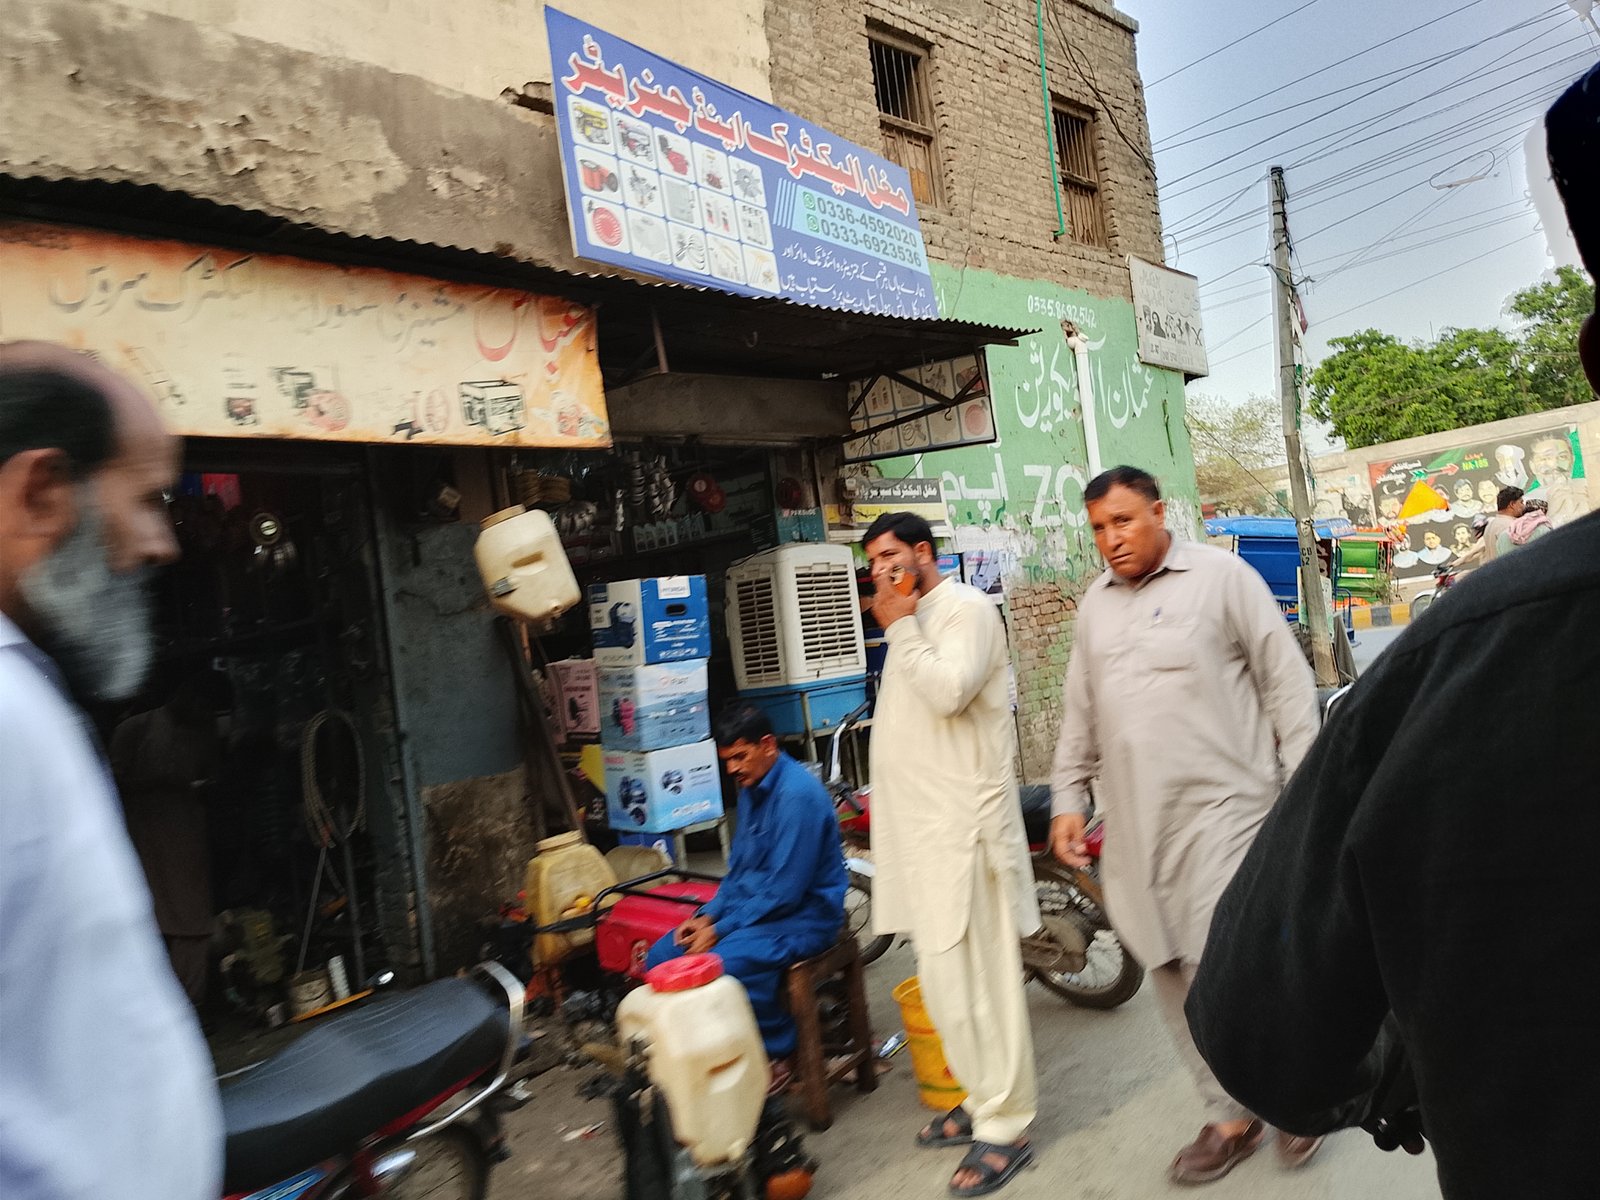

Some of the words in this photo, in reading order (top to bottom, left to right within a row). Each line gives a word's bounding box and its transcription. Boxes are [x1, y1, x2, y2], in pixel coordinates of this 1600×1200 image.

[817, 197, 918, 248] 0336-4592020
[820, 219, 922, 268] 0333-6923536
[1023, 464, 1092, 528] ZO
